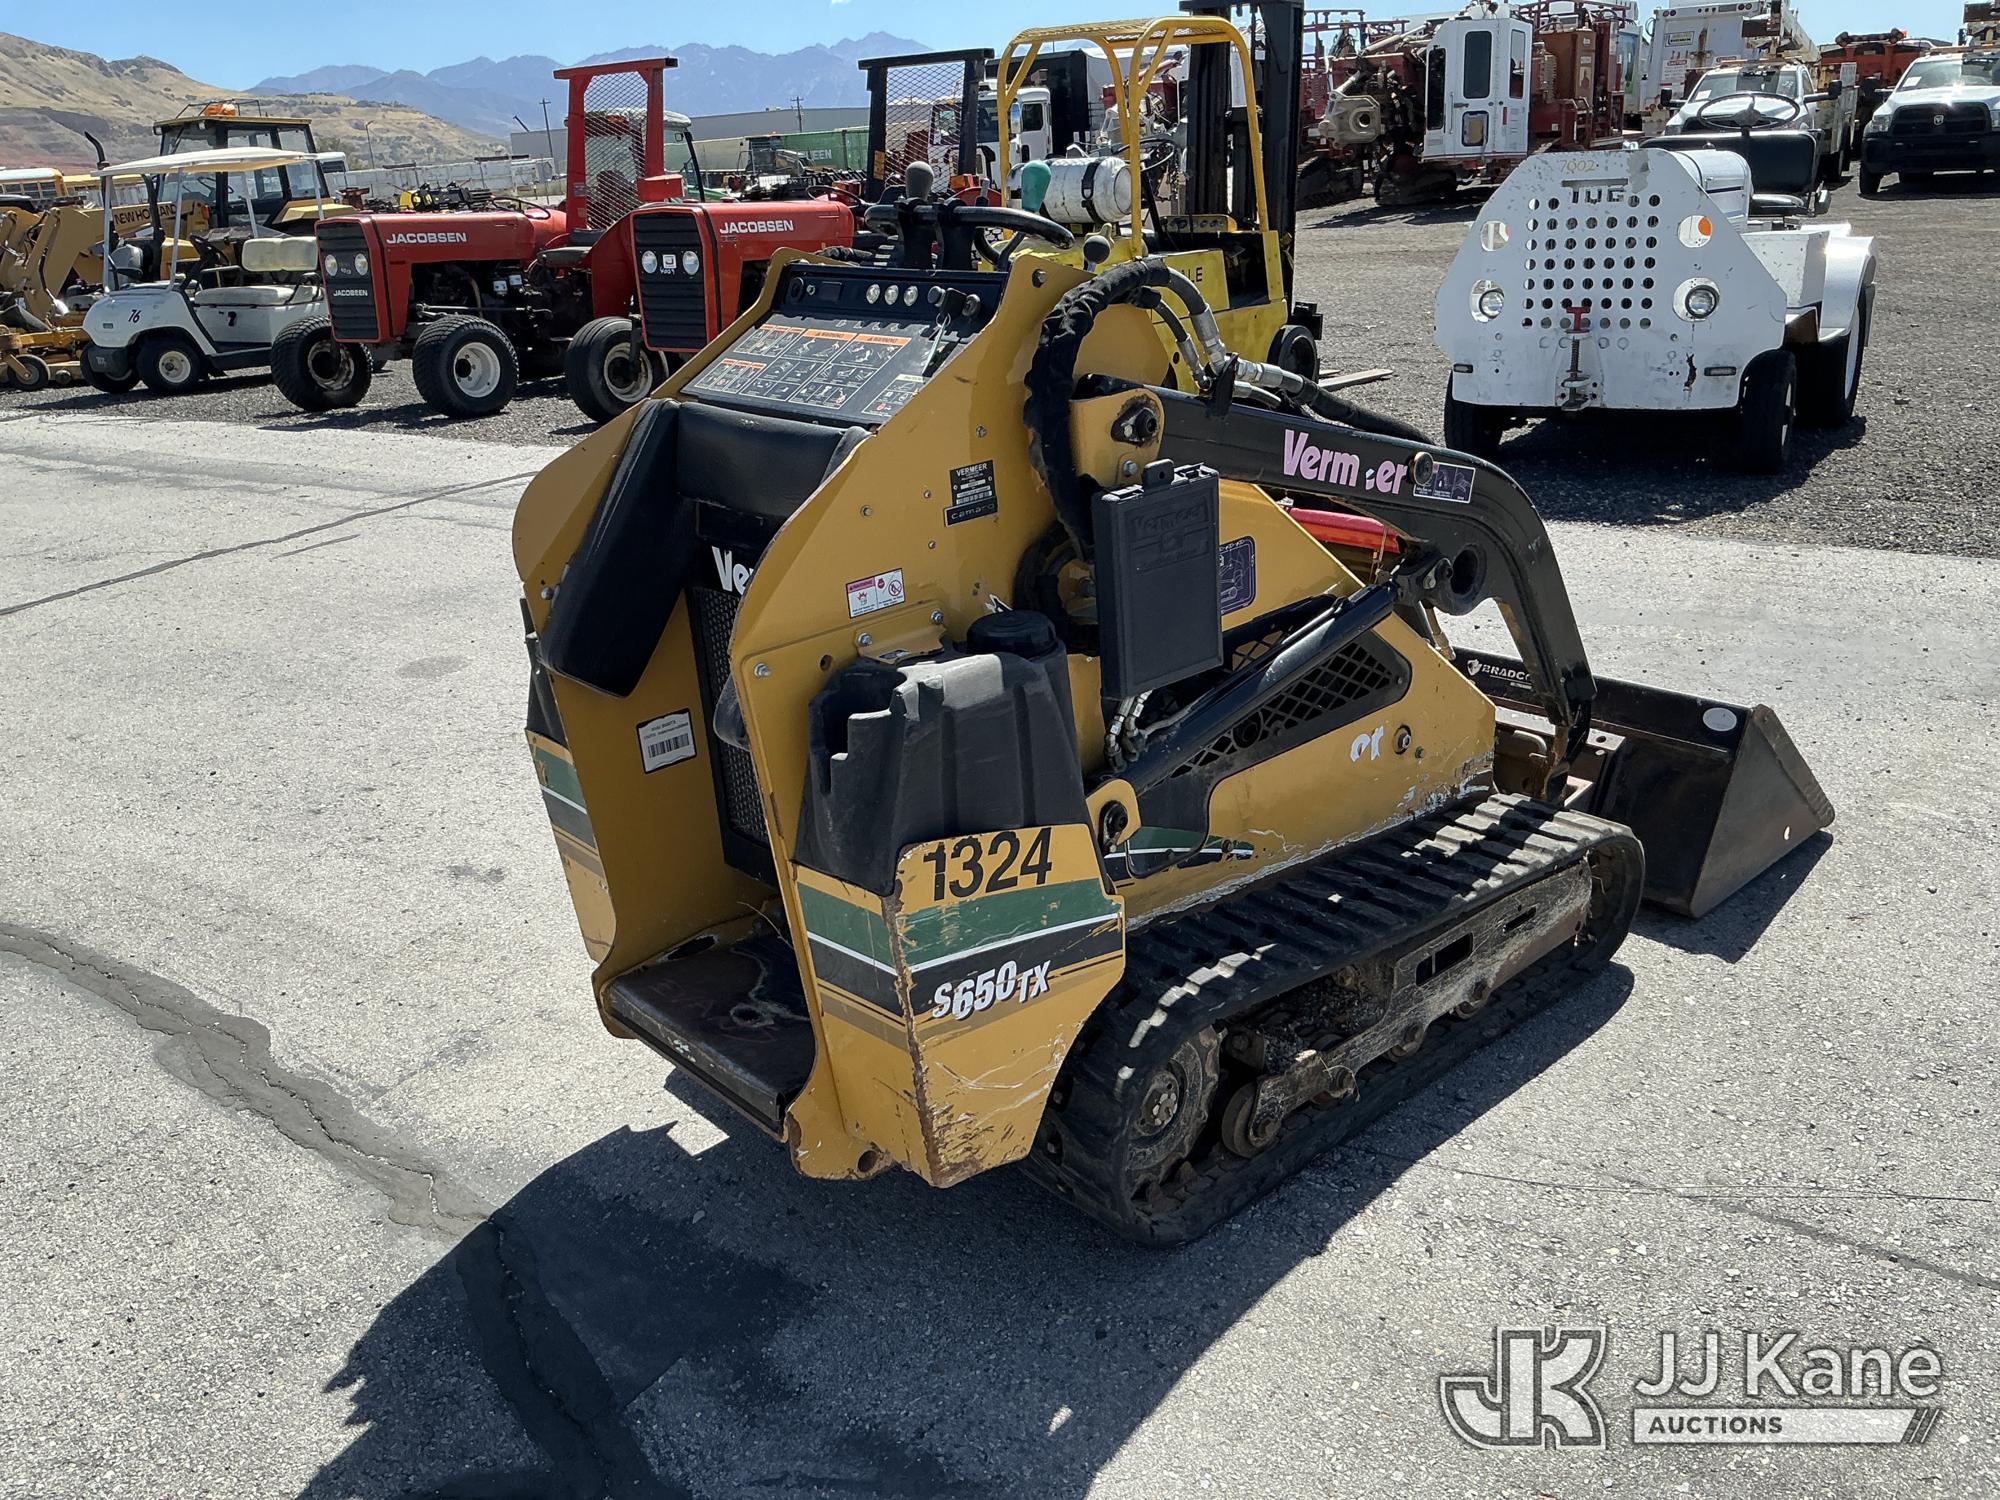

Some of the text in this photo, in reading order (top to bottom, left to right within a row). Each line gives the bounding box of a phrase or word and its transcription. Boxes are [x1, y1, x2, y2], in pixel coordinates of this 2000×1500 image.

[1560, 160, 1595, 172] 7002
[1562, 178, 1627, 204] TUG
[114, 204, 177, 225] NEW HOAND
[719, 219, 794, 234] JACOBSEN
[386, 232, 467, 244] JACOBSEN
[333, 289, 368, 297] JACOBSEN
[128, 309, 141, 323] 76
[956, 463, 988, 477] VERMEER
[711, 545, 754, 596] Ve
[923, 826, 1053, 901] 1324
